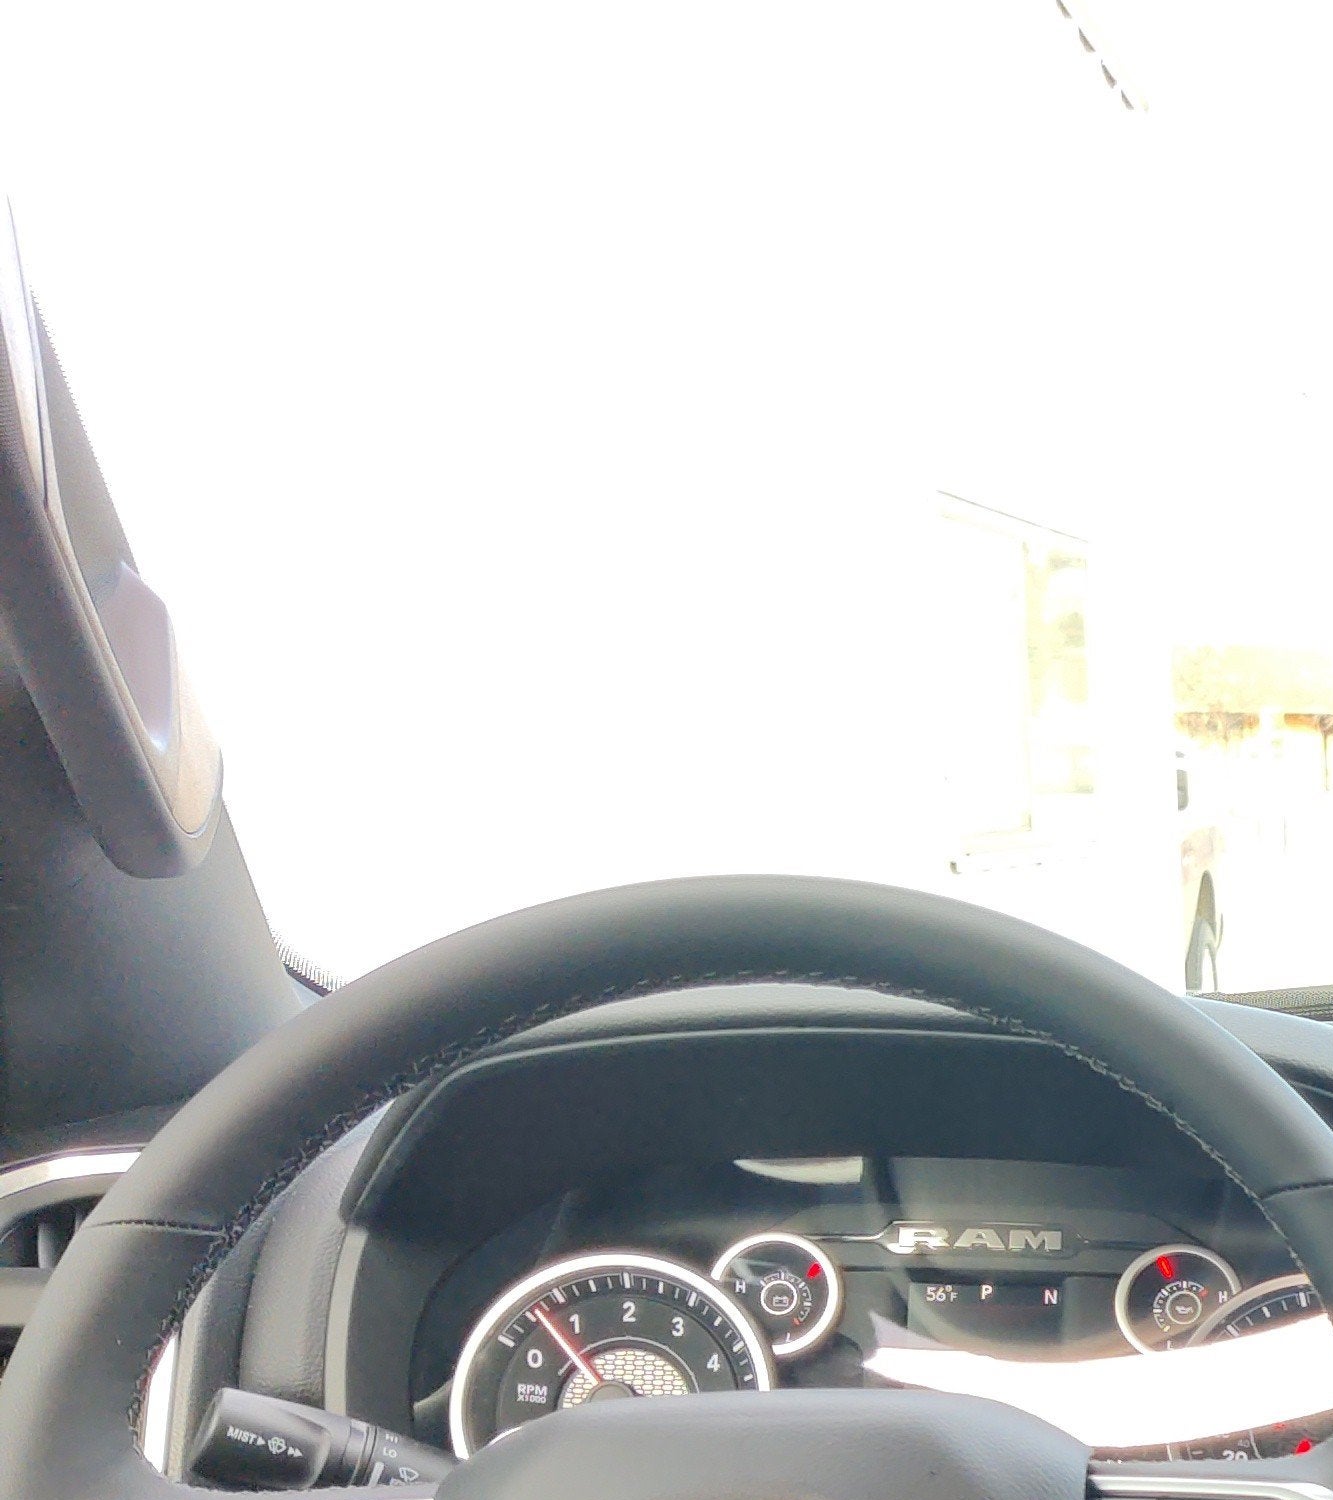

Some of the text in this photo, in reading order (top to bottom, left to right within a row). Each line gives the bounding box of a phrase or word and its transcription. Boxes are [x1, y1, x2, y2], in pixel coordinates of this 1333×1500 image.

[898, 1227, 1063, 1252] RAM
[980, 1285, 994, 1300] P
[1044, 1289, 1058, 1305] N
[622, 1301, 637, 1322] 2
[570, 1315, 581, 1334] 1
[671, 1317, 684, 1336] 3
[527, 1349, 543, 1369] 0
[706, 1353, 721, 1372] 4
[516, 1383, 548, 1397] RPM
[227, 1425, 257, 1445] MIST
